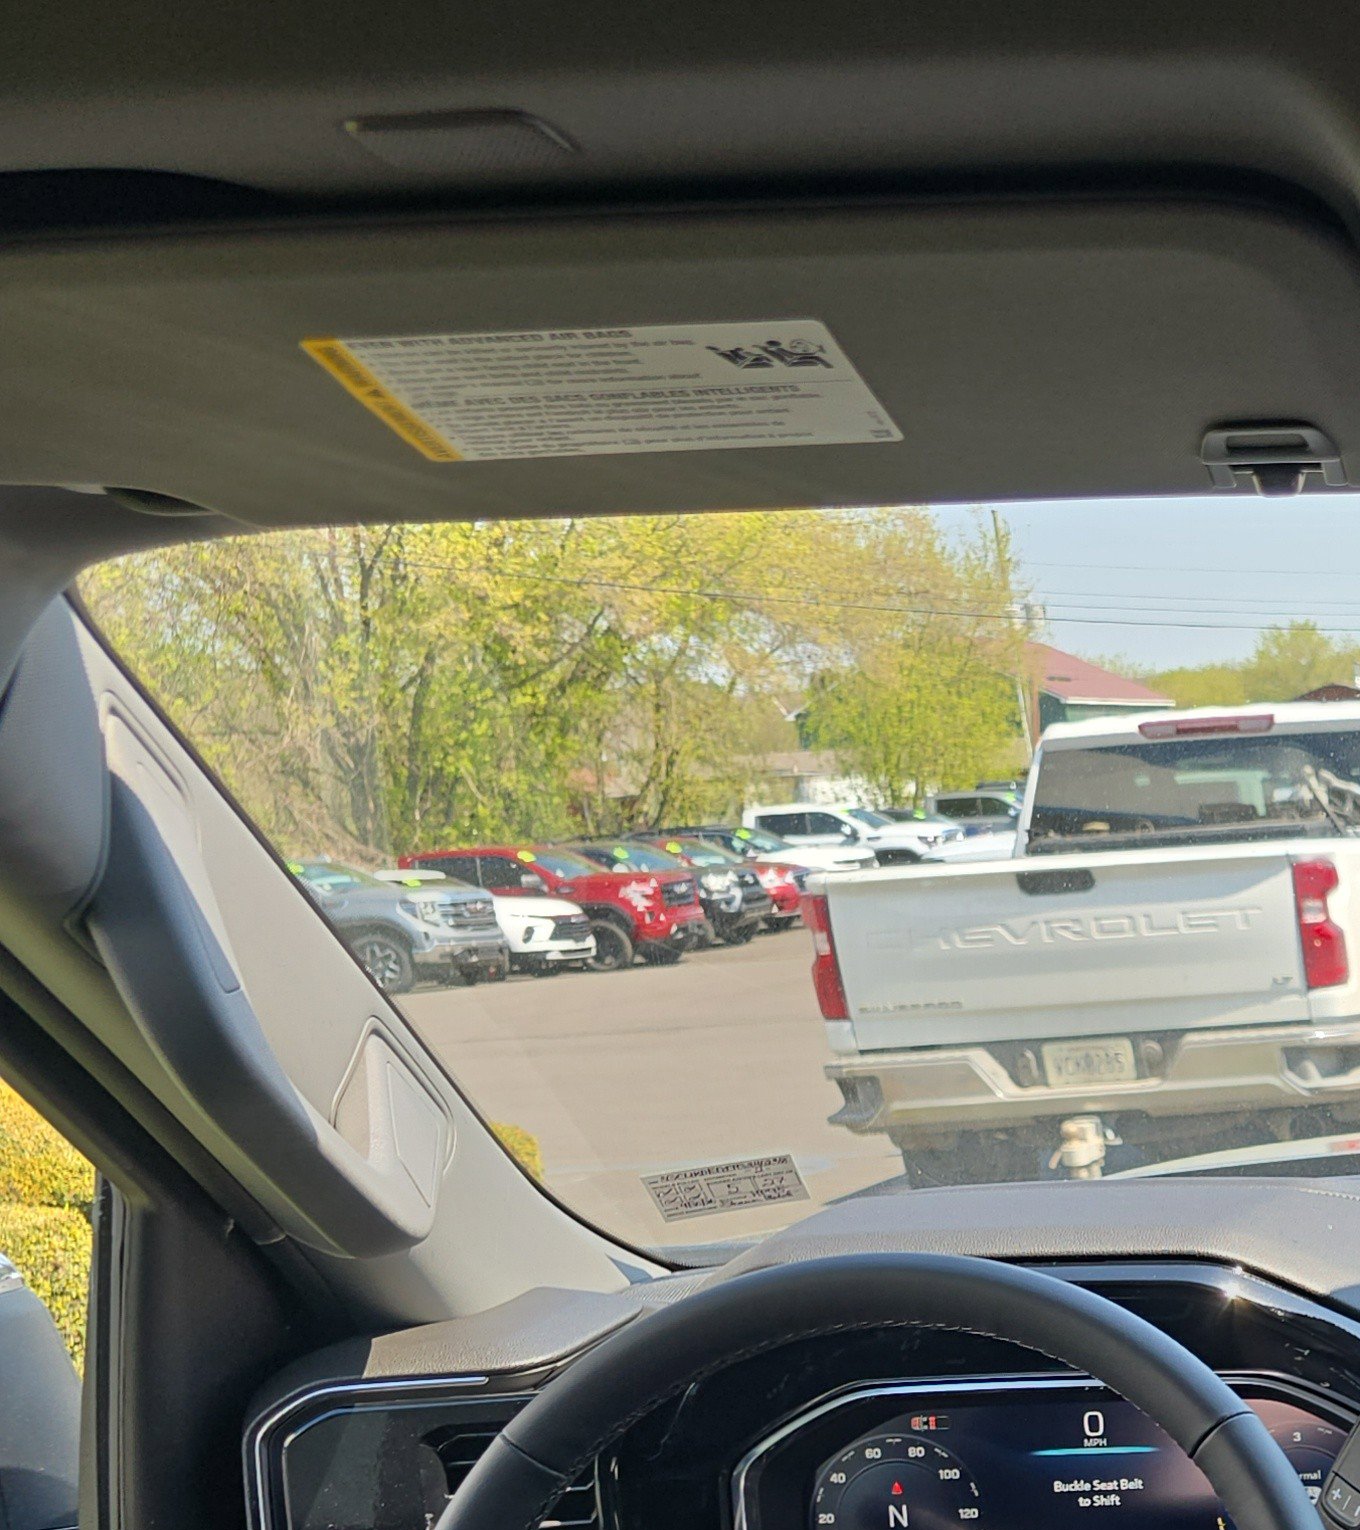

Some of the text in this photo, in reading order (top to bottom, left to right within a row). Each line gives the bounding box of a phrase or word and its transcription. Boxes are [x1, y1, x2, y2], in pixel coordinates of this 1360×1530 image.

[866, 906, 1263, 951] CHEVROLET
[1083, 1411, 1104, 1437] 0
[1083, 1438, 1107, 1447] MPH
[1293, 1432, 1302, 1442] 3
[865, 1447, 882, 1459] 60
[908, 1447, 925, 1457] 80
[830, 1473, 846, 1484] 40
[938, 1468, 960, 1480] 100
[1053, 1478, 1144, 1492] Buckle Seat Belt
[1078, 1495, 1121, 1507] to Shift
[818, 1513, 835, 1524] 20
[888, 1504, 909, 1528] N
[958, 1508, 979, 1519] 120
